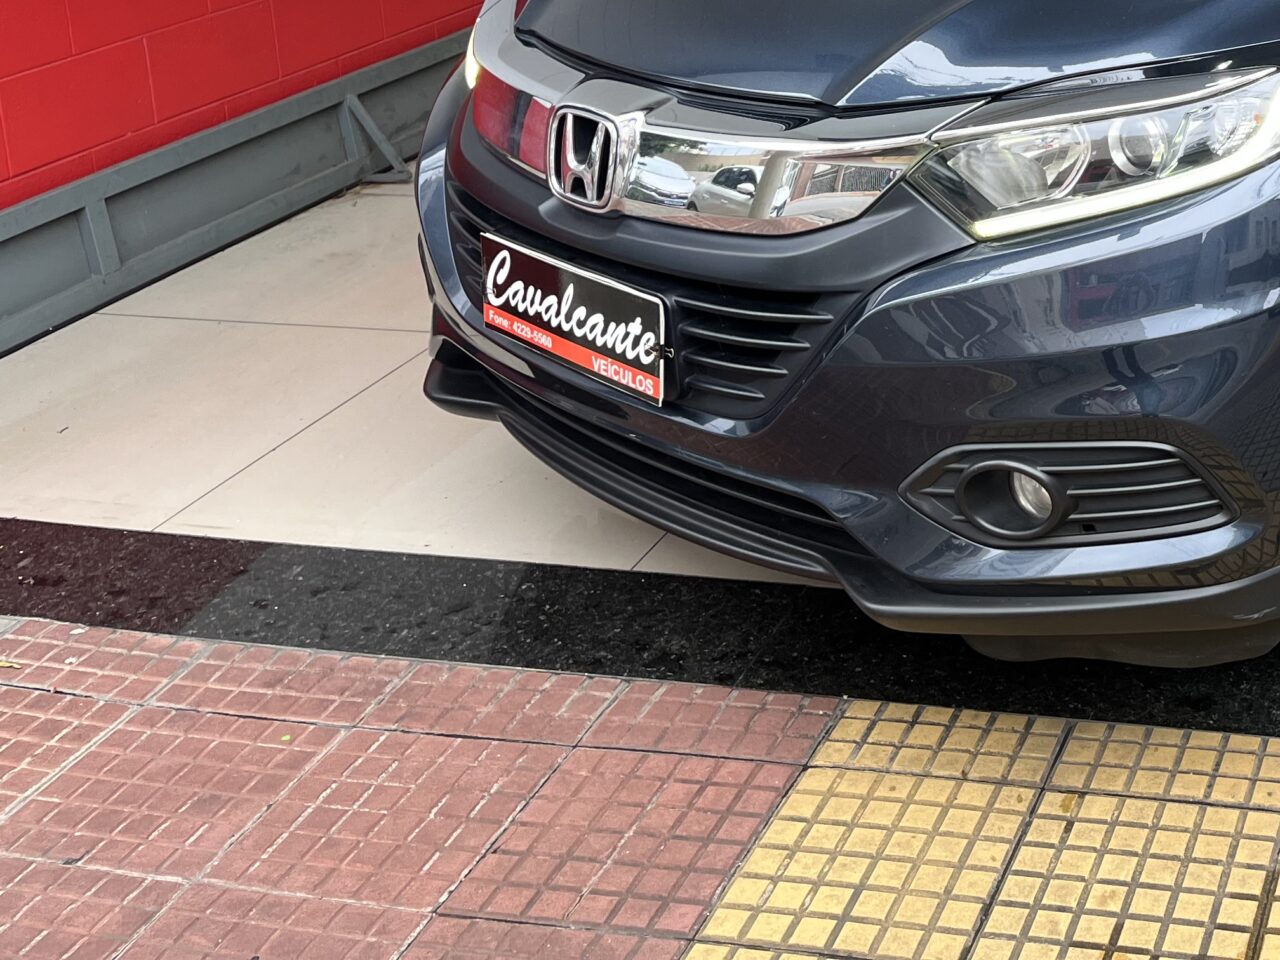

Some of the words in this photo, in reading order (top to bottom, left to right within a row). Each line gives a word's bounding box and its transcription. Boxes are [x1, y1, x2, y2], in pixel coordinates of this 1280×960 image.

[486, 249, 656, 365] Cavalcante
[488, 309, 511, 330] Fone:
[591, 355, 654, 395] VEÍCULOS
